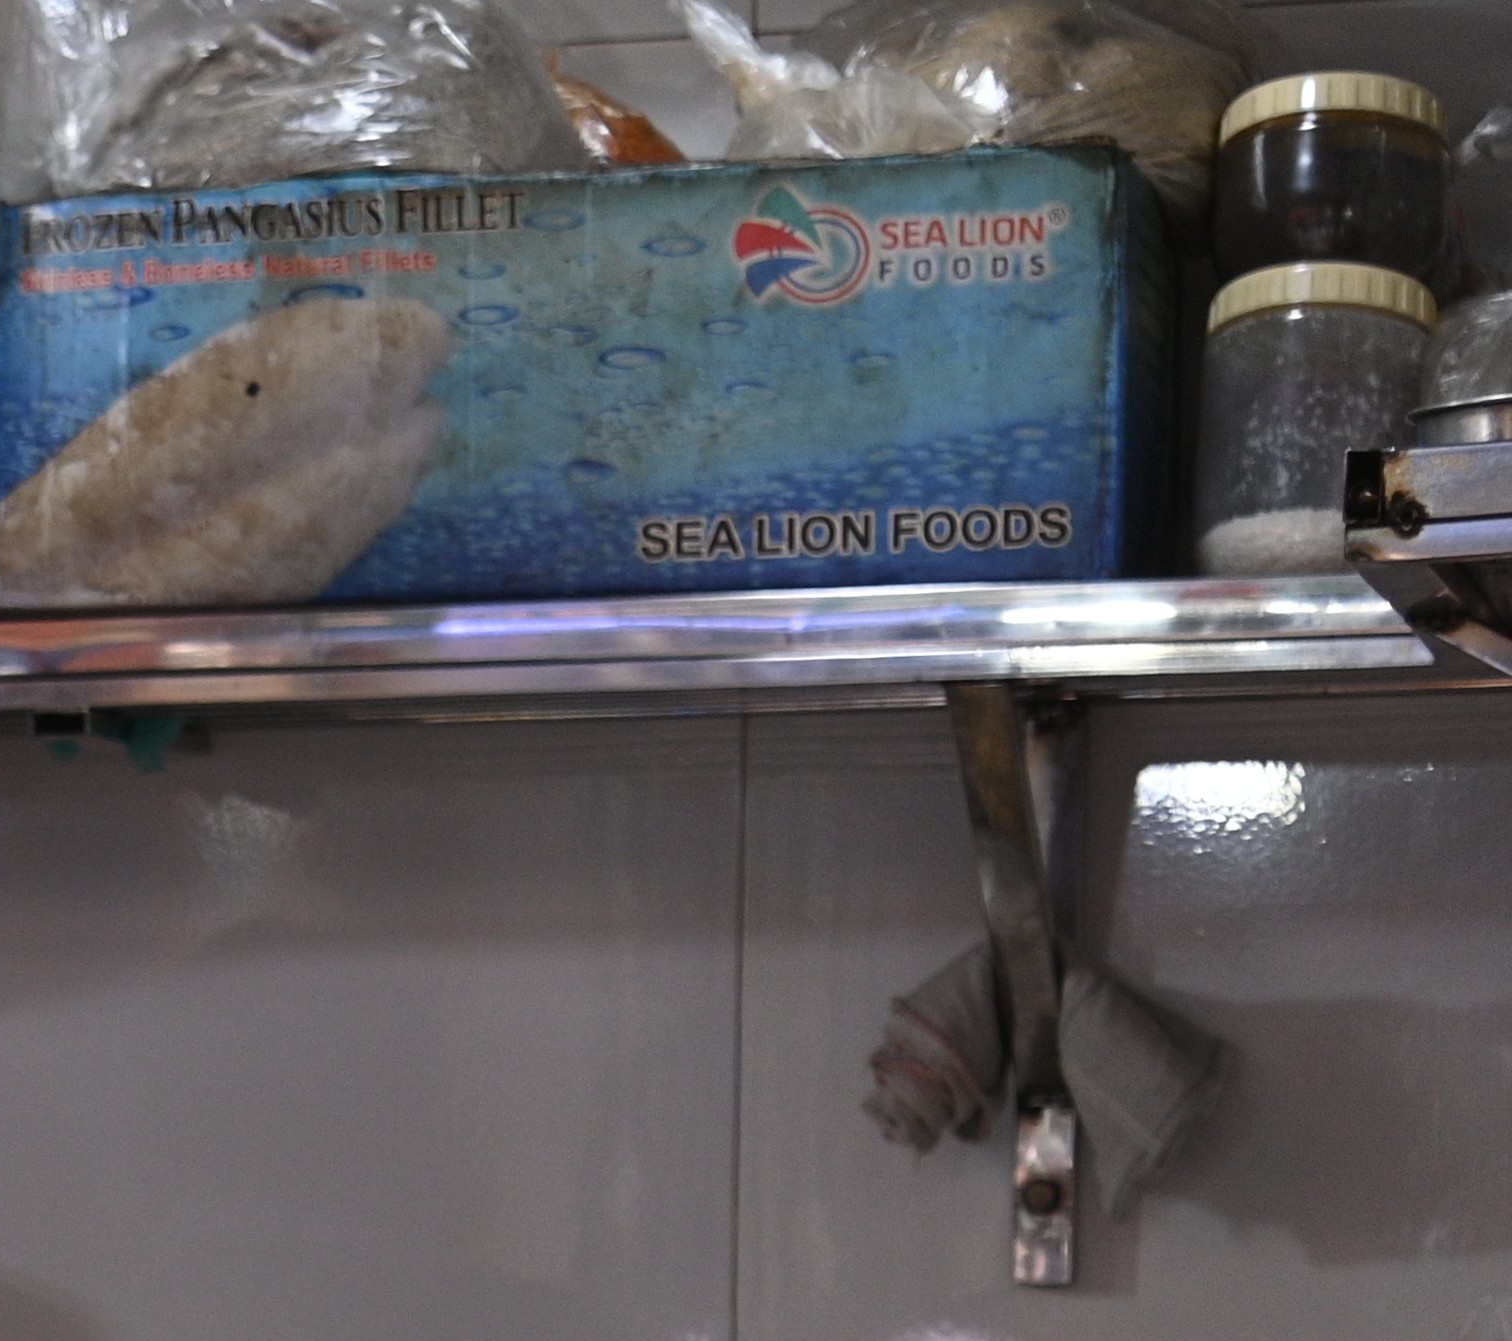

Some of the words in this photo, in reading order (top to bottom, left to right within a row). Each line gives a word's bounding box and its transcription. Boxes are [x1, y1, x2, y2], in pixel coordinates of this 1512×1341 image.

[21, 208, 162, 254] FROZEN
[171, 194, 384, 245] PANGASIUS
[394, 188, 525, 232] FILLET
[880, 219, 947, 250] SEA
[959, 215, 1046, 247] LION
[878, 254, 1046, 282] FOODS
[640, 517, 742, 561] SEA
[755, 512, 875, 557] LION
[889, 504, 1071, 553] FOODS
